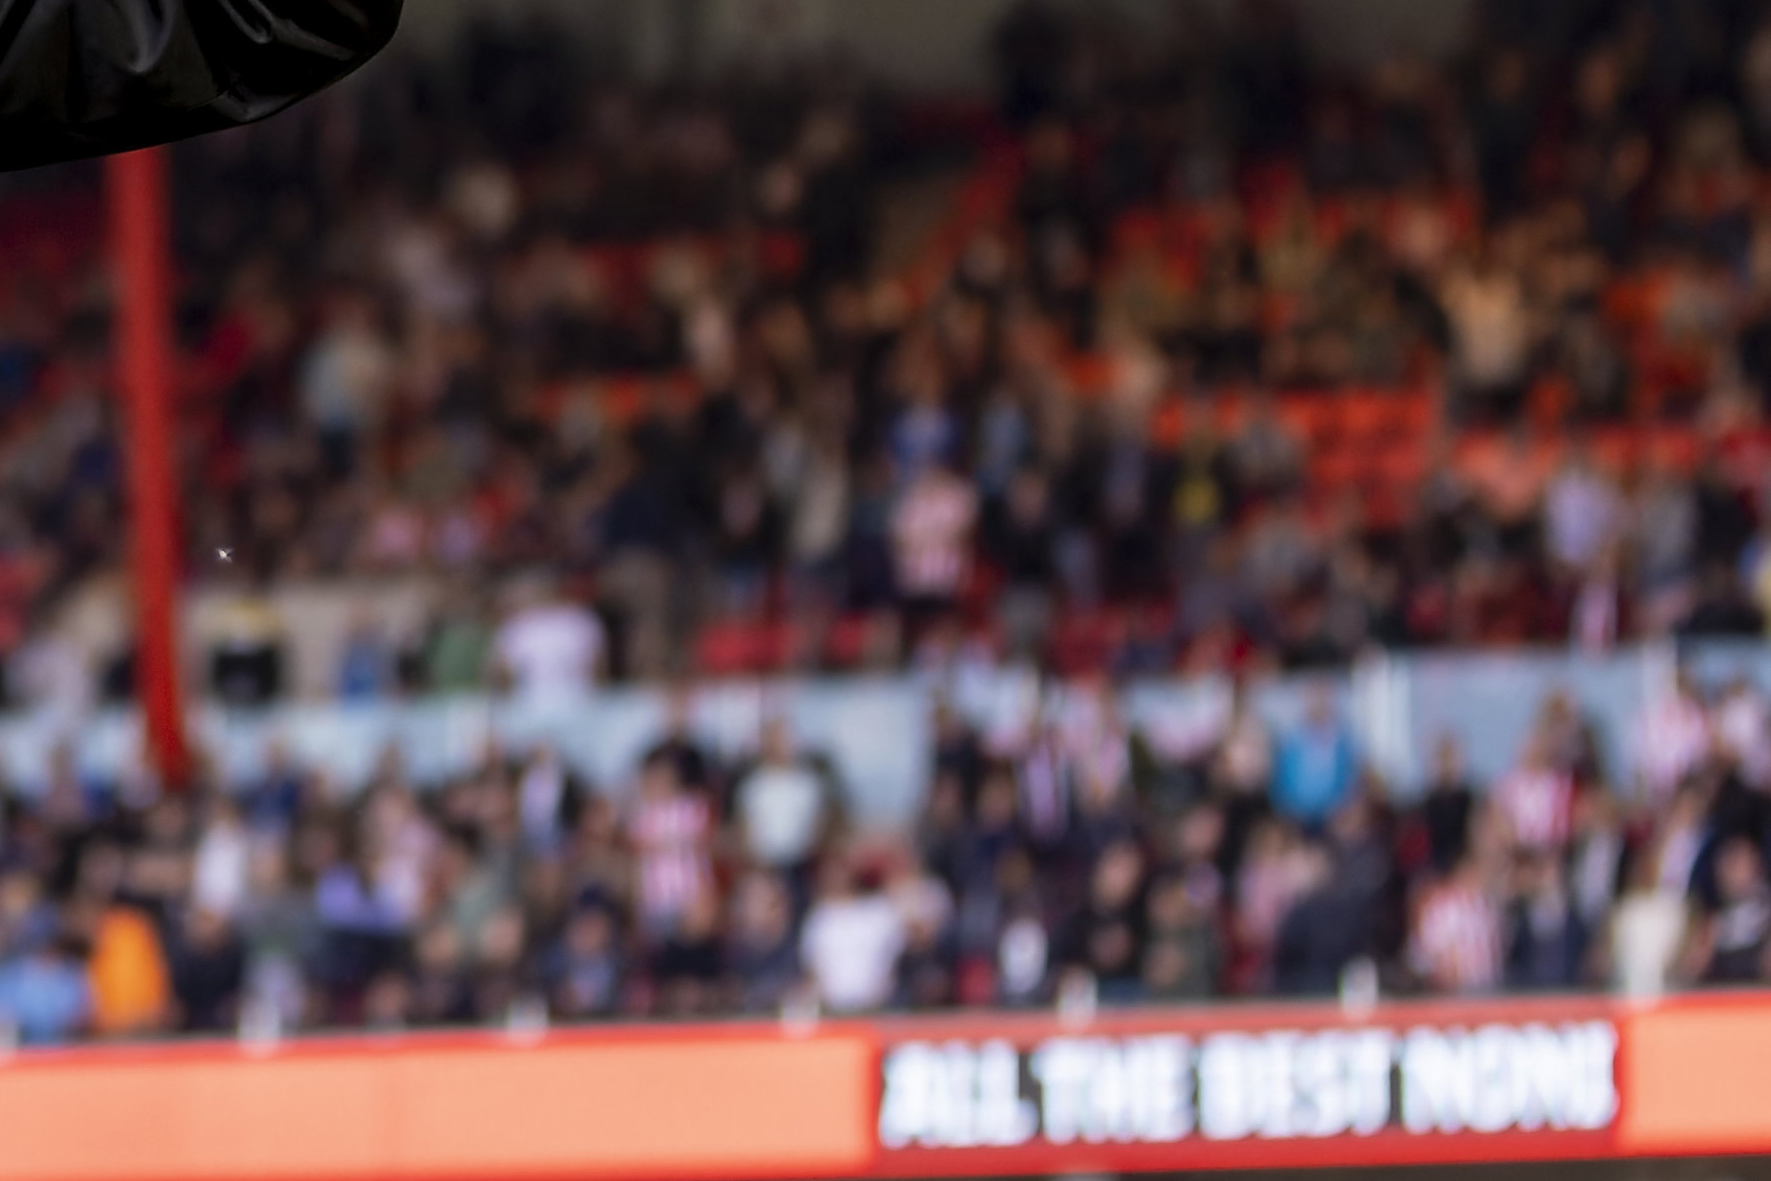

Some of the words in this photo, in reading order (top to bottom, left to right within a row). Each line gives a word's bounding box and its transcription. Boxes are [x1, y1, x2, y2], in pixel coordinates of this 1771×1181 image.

[881, 1039, 1035, 1147] ALL
[1032, 1034, 1194, 1144] THE
[1198, 1028, 1396, 1140] BEST
